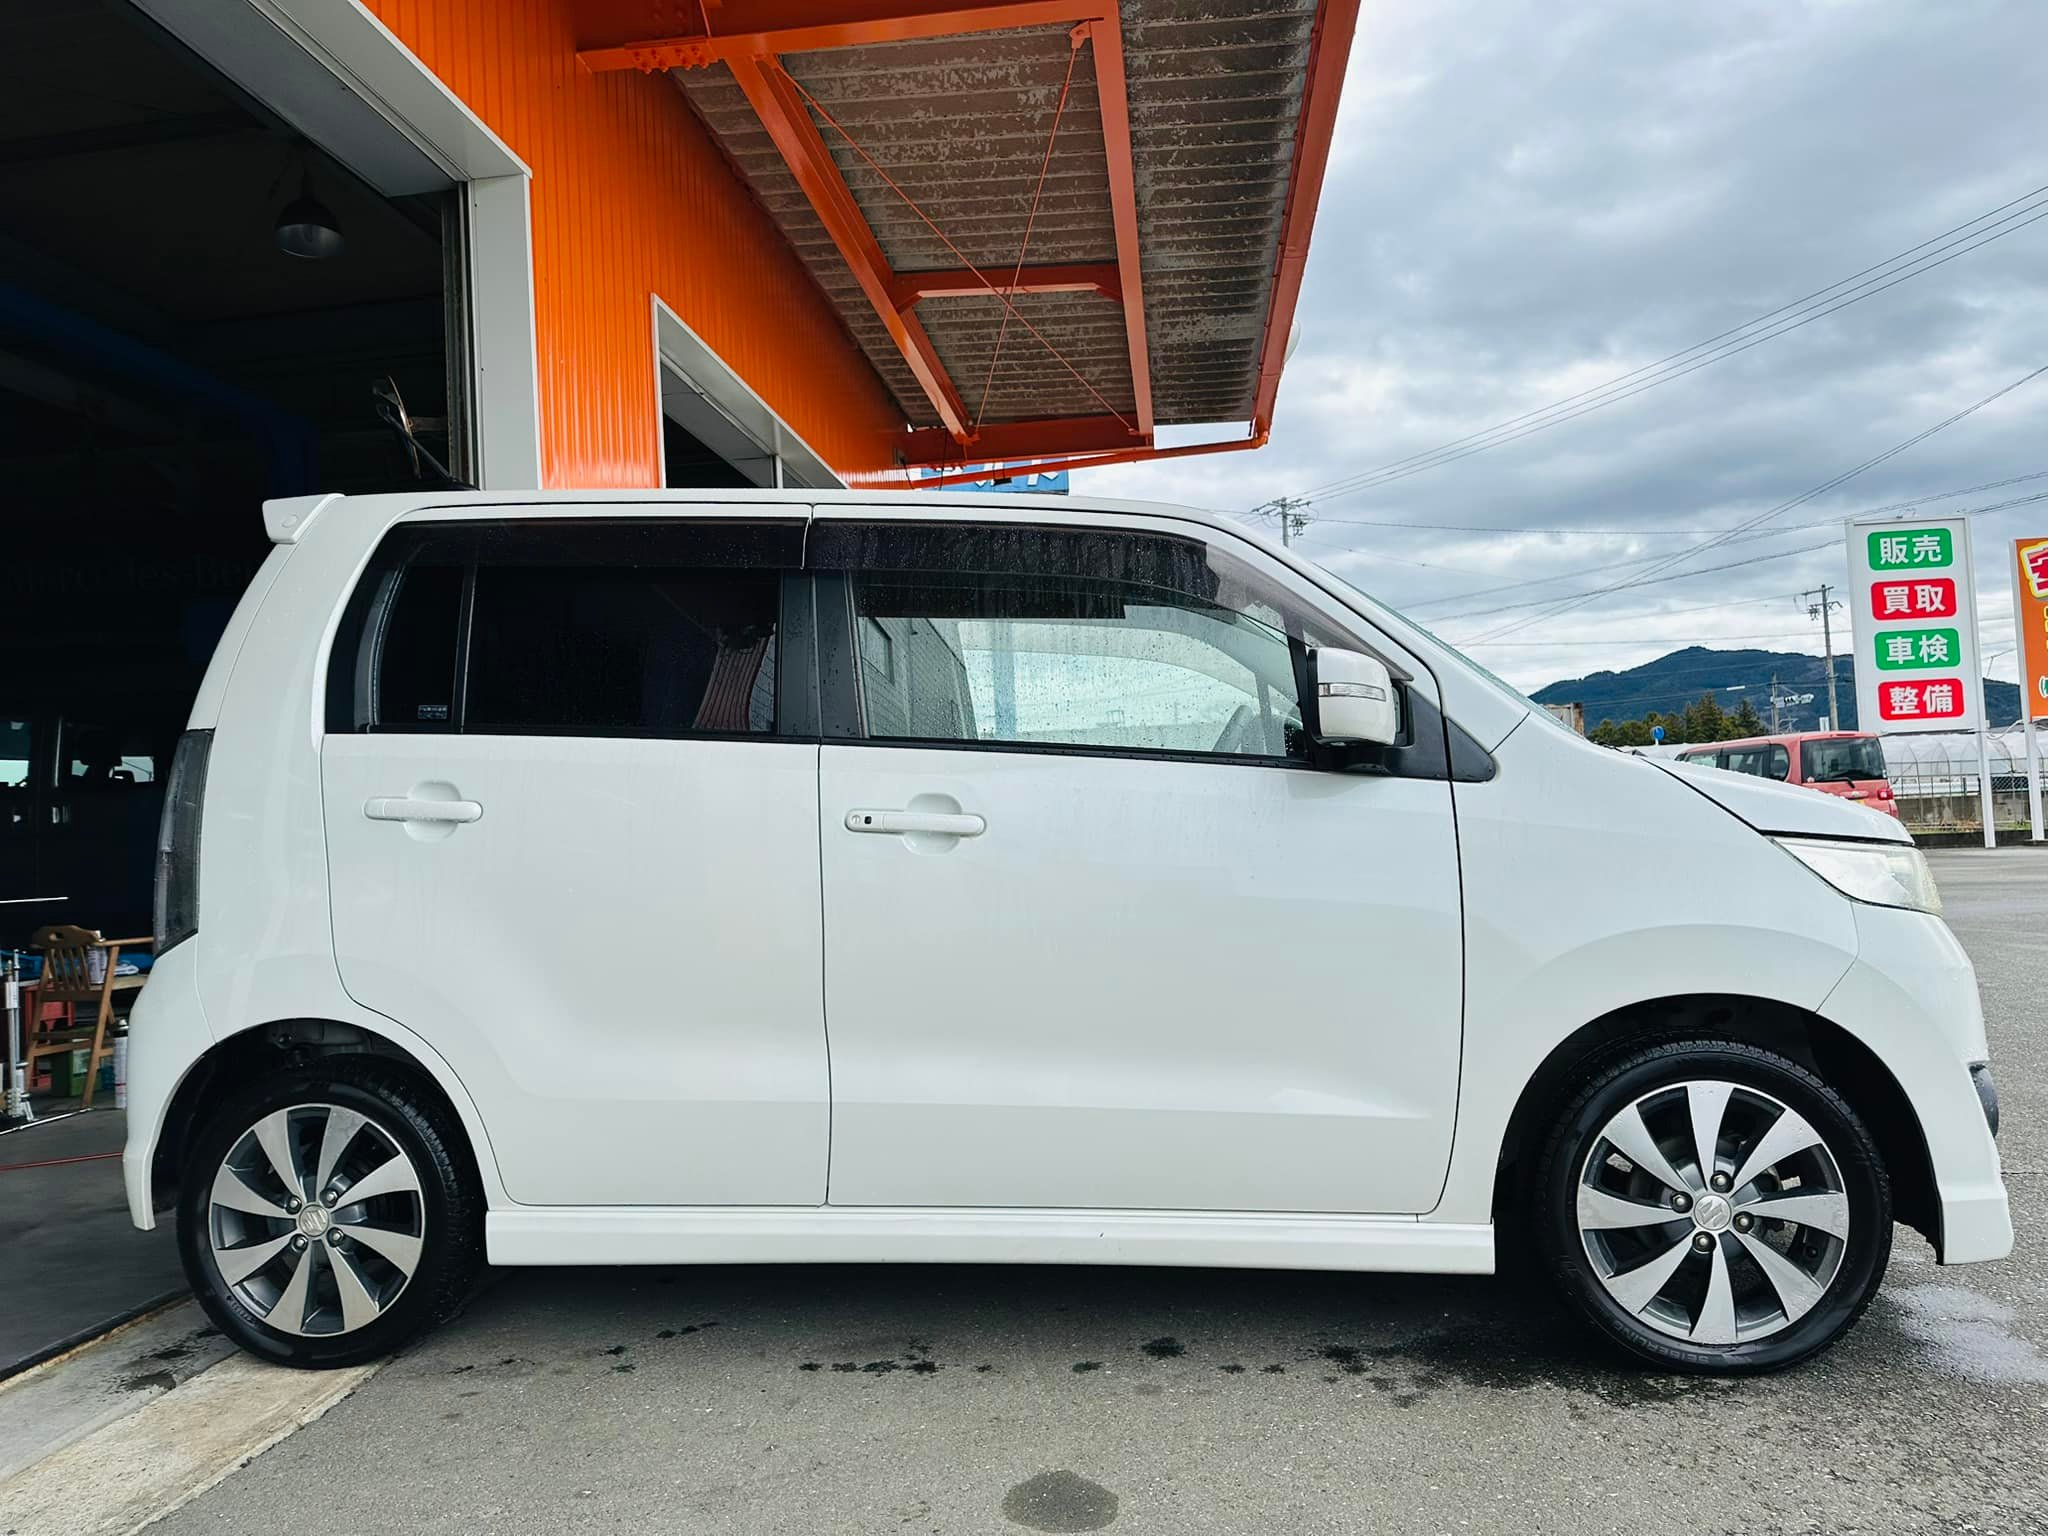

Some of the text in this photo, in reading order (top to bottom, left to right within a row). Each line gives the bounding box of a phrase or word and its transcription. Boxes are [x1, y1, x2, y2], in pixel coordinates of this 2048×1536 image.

[1880, 534, 1942, 565] 販売
[1883, 584, 1946, 615] 買取
[1886, 633, 1950, 664] 車検
[1889, 684, 1953, 716] 整備
